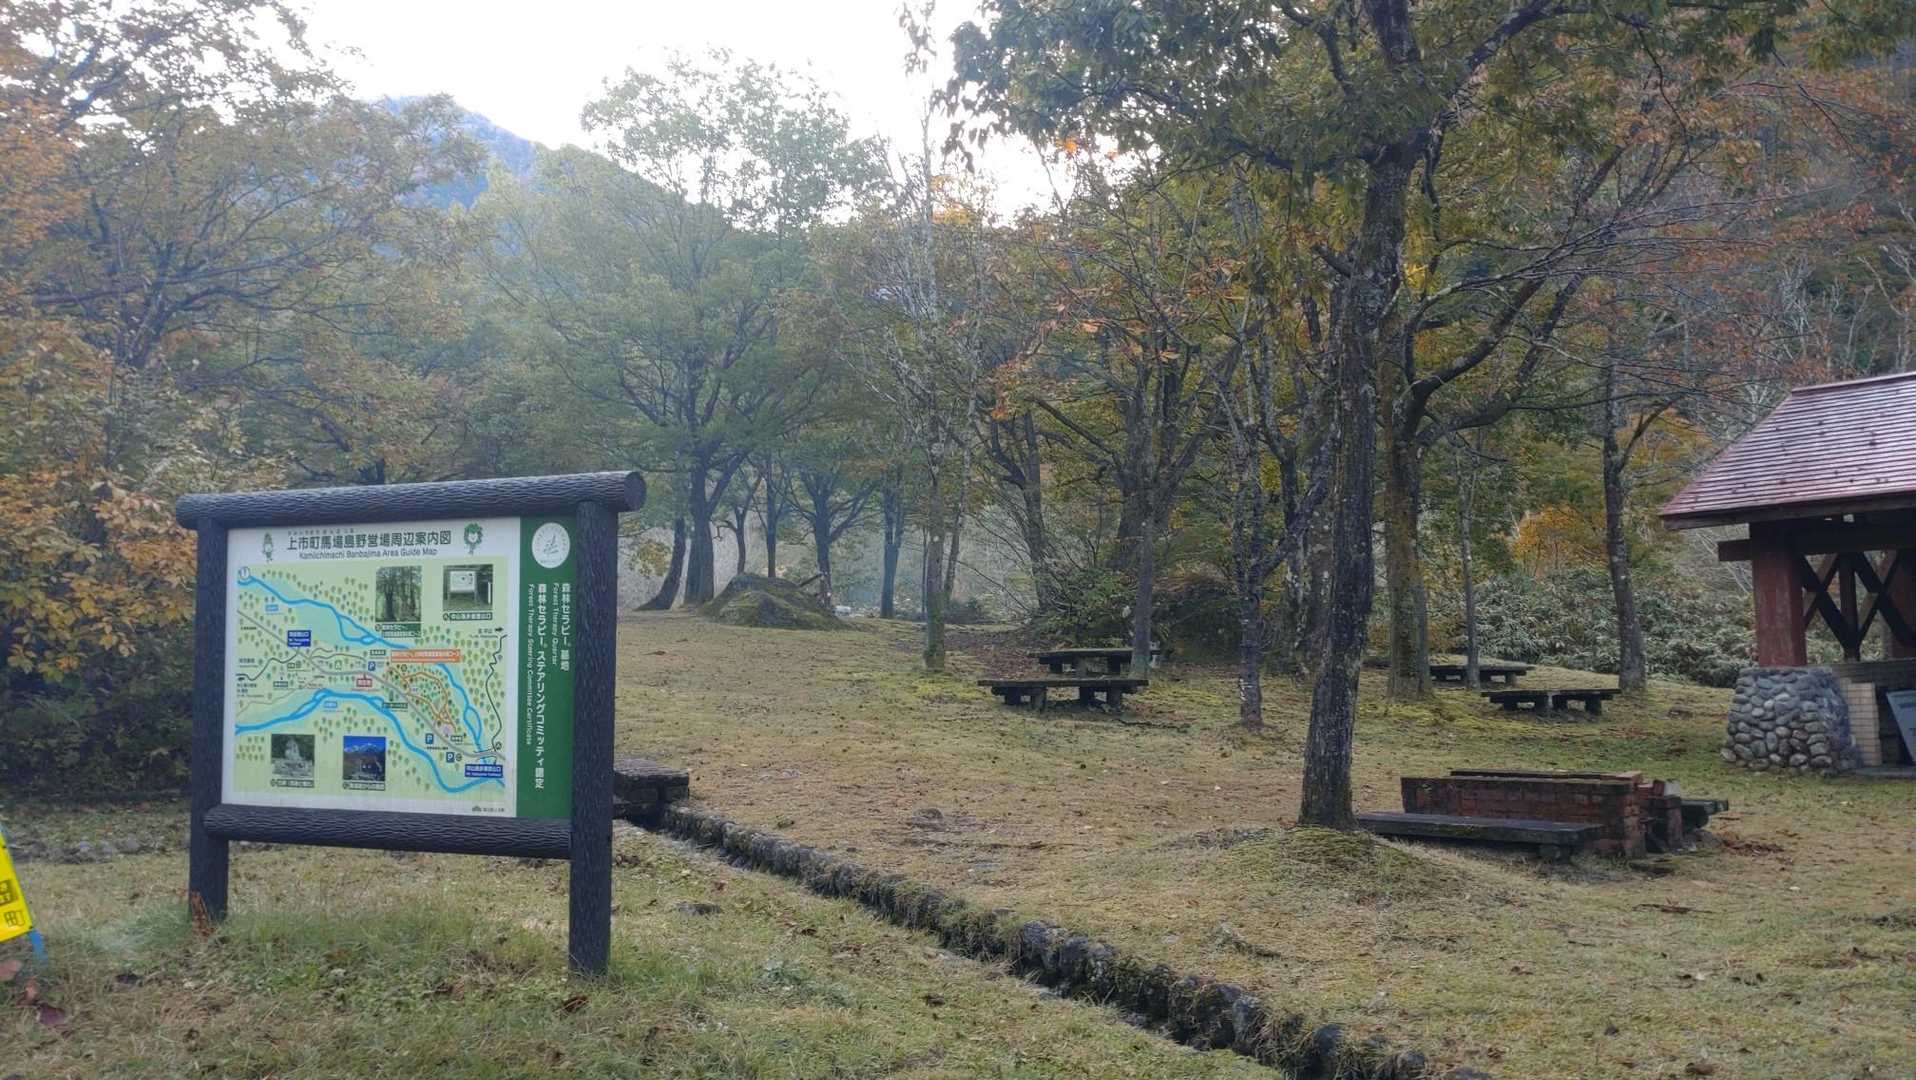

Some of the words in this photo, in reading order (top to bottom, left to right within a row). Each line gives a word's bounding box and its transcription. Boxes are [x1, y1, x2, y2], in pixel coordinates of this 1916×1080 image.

[287, 531, 451, 550] 上市町馬場島野営場周辺案内図
[383, 549, 399, 557] Area
[401, 548, 420, 557] Guide
[422, 547, 437, 556] Map
